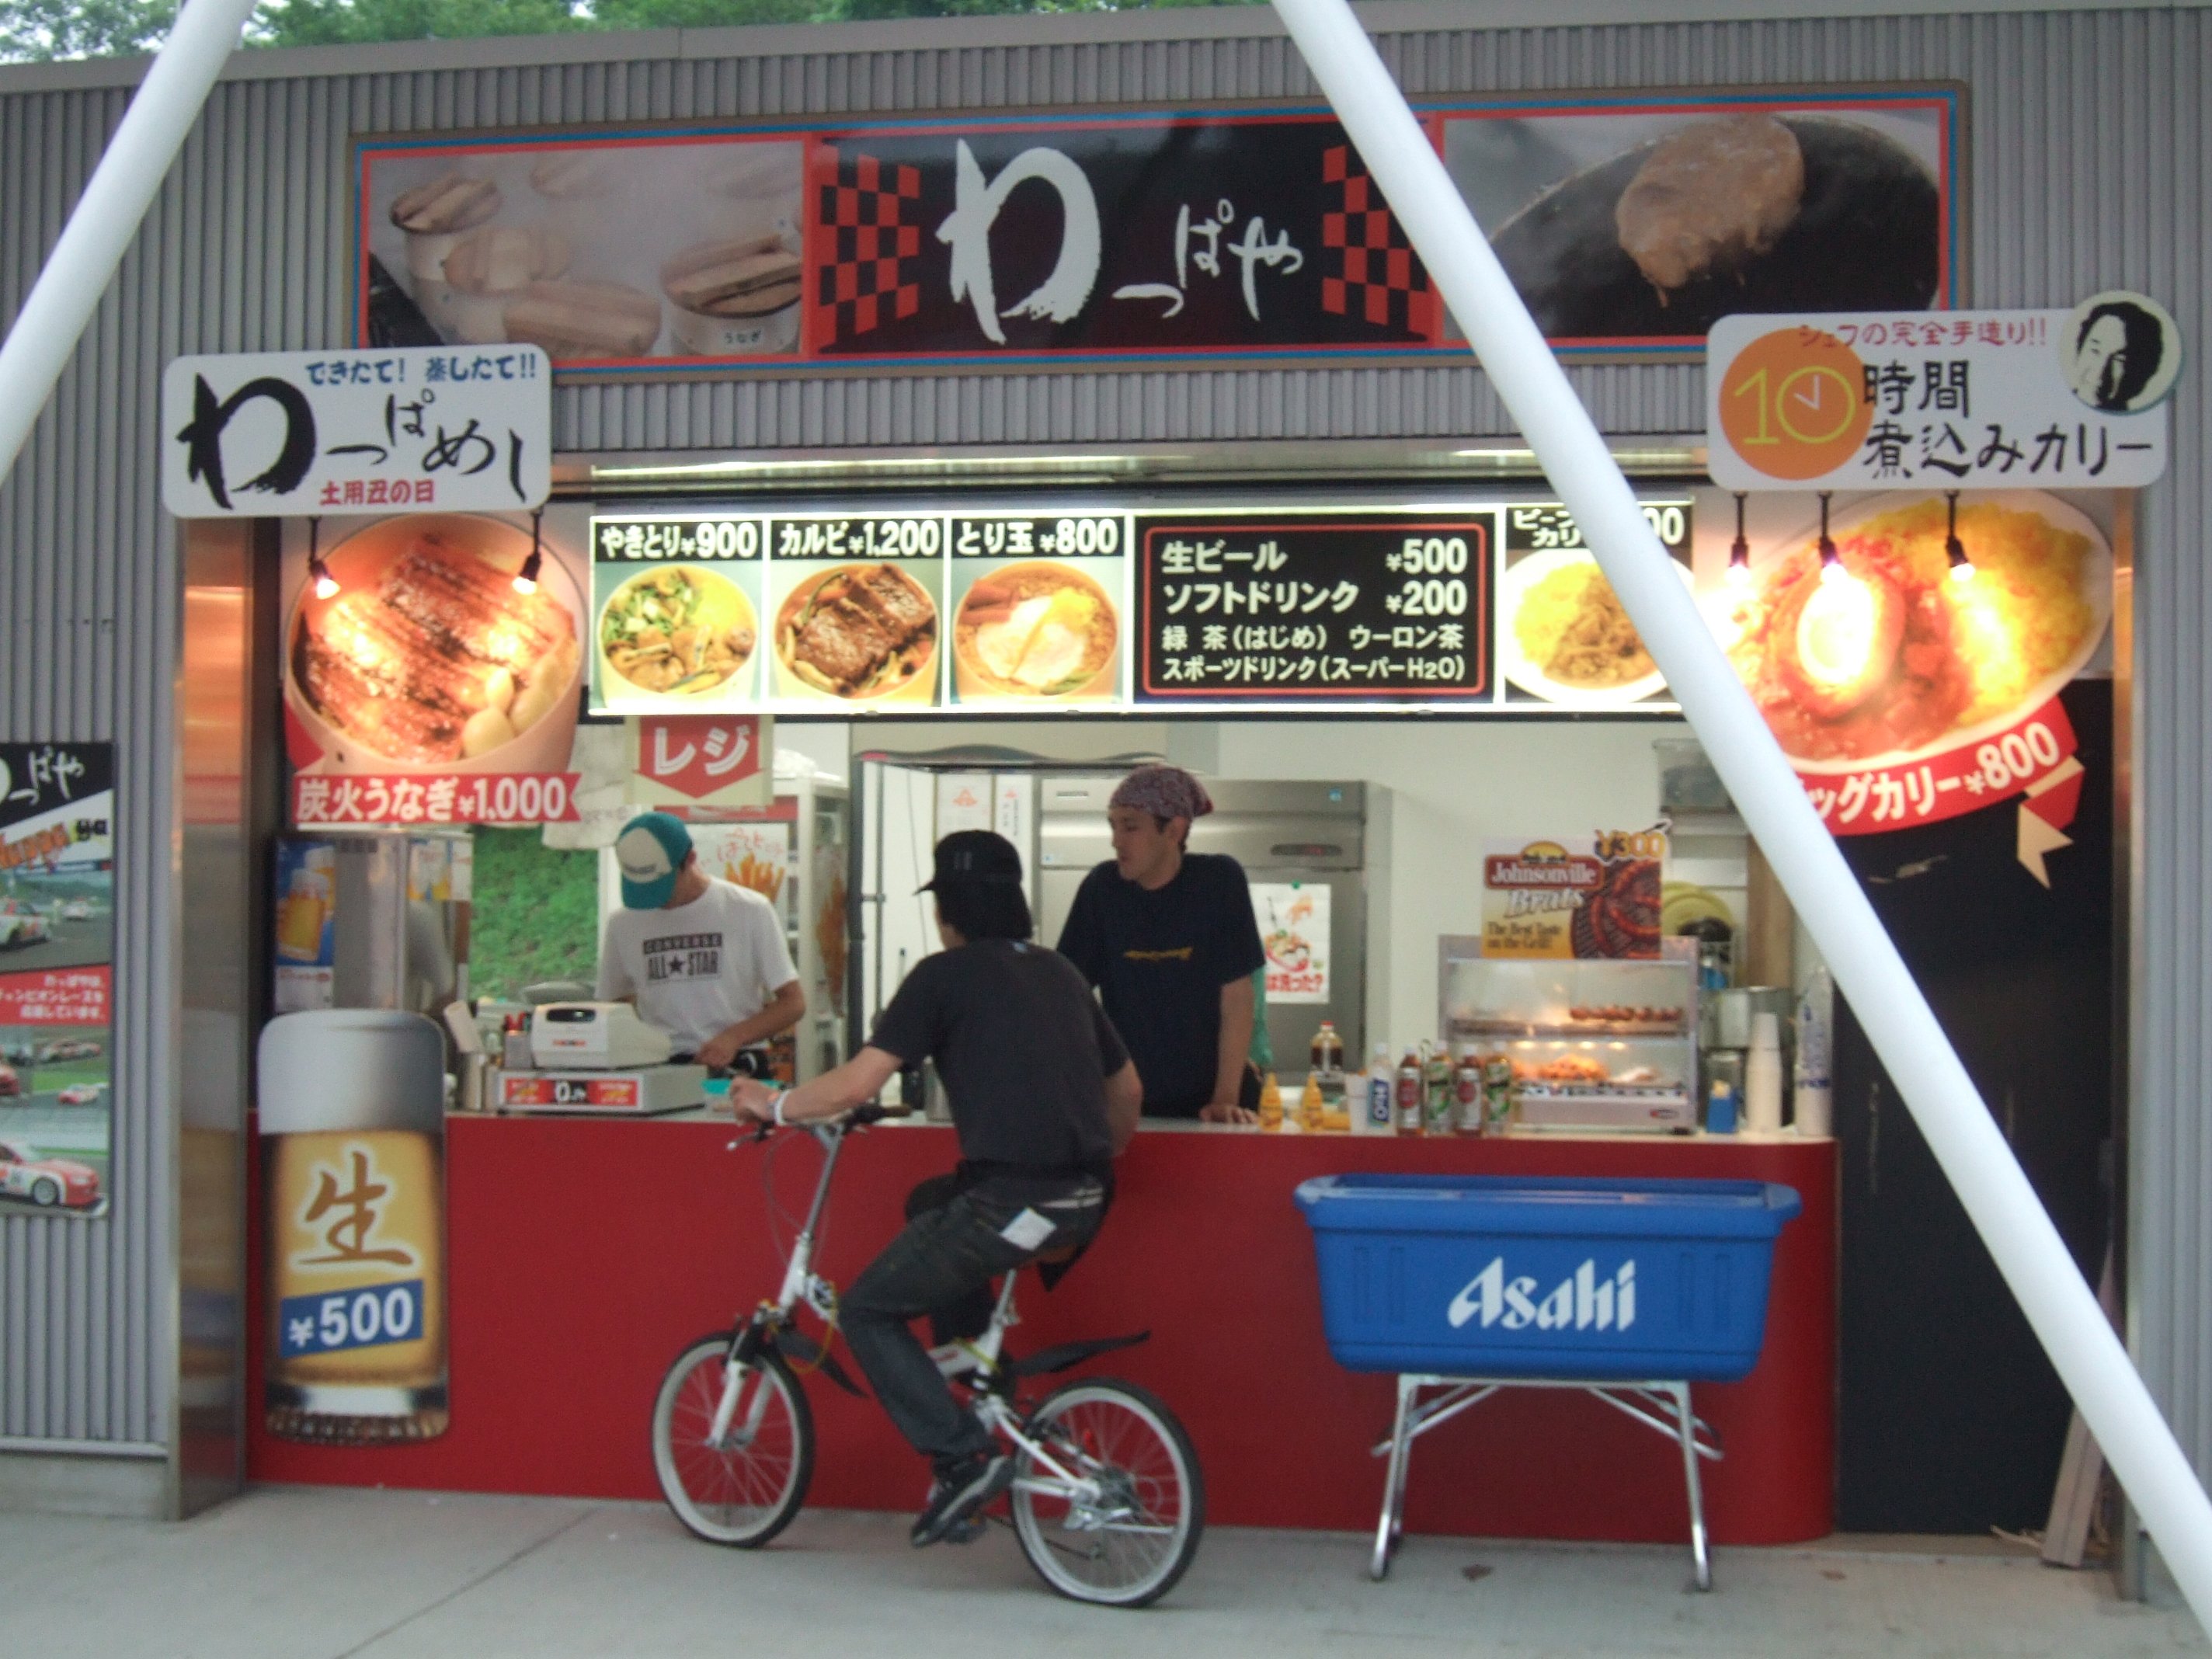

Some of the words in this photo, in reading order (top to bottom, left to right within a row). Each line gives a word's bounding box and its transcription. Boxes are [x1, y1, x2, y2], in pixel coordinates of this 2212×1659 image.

[935, 137, 1303, 345] わっぱや
[1862, 360, 1970, 417] 時間
[176, 373, 526, 510] わっぱめし
[1864, 423, 2153, 478] 煮込みカリー
[319, 478, 435, 506] 土用丑の日
[1162, 540, 1288, 573] 生ビール
[1386, 537, 1469, 575] ¥500
[1163, 579, 1360, 615] ソフトドリンク
[1386, 579, 1469, 616] ¥200
[1348, 624, 1463, 650] ウーロン茶
[0, 746, 85, 805] っぱや
[654, 724, 751, 776] レジ
[1491, 861, 1596, 885] Johnsonville
[298, 1149, 414, 1266] 生
[288, 1287, 414, 1348] ¥500
[1448, 1256, 1636, 1330] Asahi
